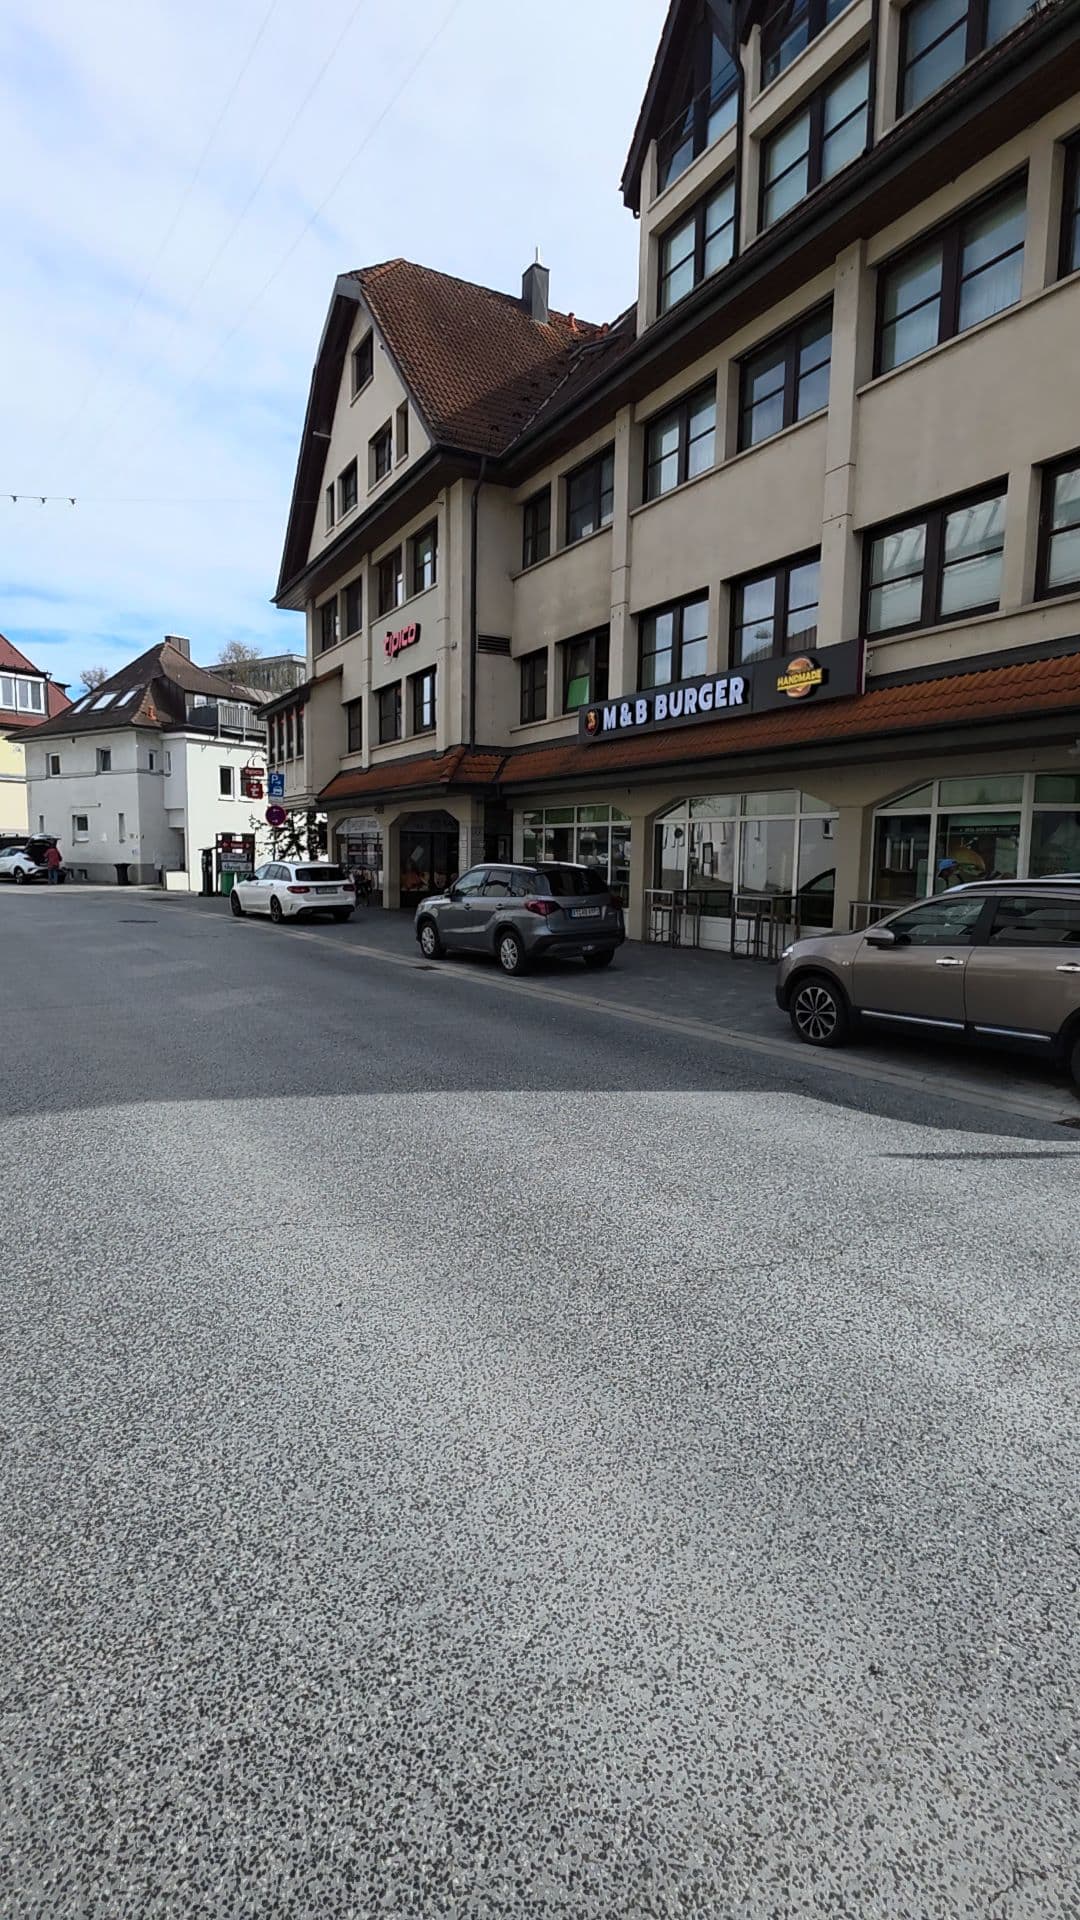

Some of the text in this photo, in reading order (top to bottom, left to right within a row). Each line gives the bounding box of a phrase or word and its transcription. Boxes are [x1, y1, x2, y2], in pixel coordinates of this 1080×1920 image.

[777, 668, 822, 688] HANDMADE
[655, 676, 744, 720] BURGER
[271, 774, 279, 785] P
